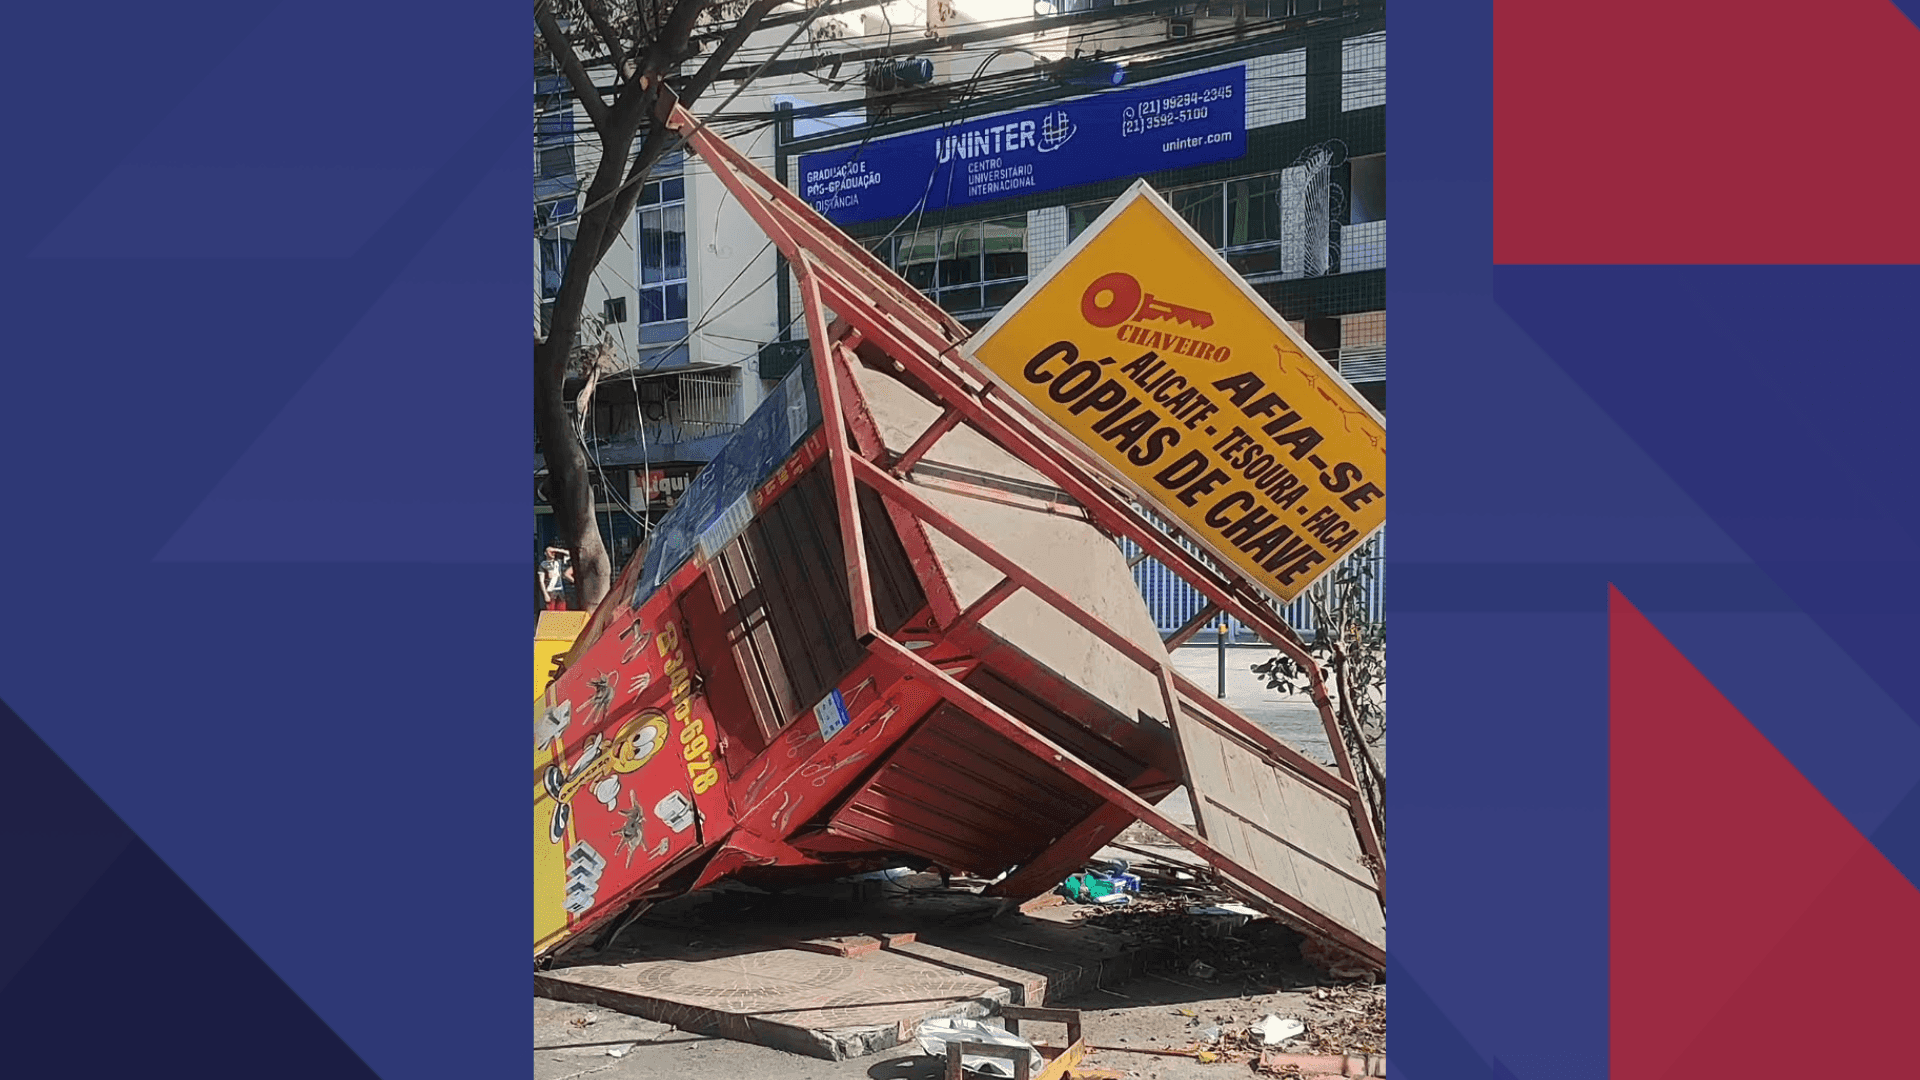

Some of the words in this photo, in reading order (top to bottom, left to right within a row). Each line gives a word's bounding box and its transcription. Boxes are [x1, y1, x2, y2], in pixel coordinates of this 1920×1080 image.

[1122, 118, 1145, 137] (21)
[1146, 106, 1208, 129] 3592-5100
[1138, 99, 1160, 118] (21)
[936, 120, 1035, 164] UNINTER
[1162, 131, 1232, 152] uninter.com
[860, 161, 866, 173] E
[968, 157, 1003, 173] CENTRO
[968, 164, 1033, 185] UNIVERSITÁRIO
[807, 171, 881, 197] PÓS-GRADUAÇÃO
[968, 176, 1036, 197] INTERNACIONAL
[1116, 323, 1231, 363] CHAVEIRO
[1121, 351, 1220, 430] ALICATE
[1211, 426, 1311, 512] TESOURA
[1301, 505, 1362, 553] FACA
[1212, 371, 1386, 513] AFIA-SE
[1023, 340, 1181, 467] CÓPIAS
[1154, 448, 1232, 508] DE
[1204, 490, 1327, 587] CHAVE
